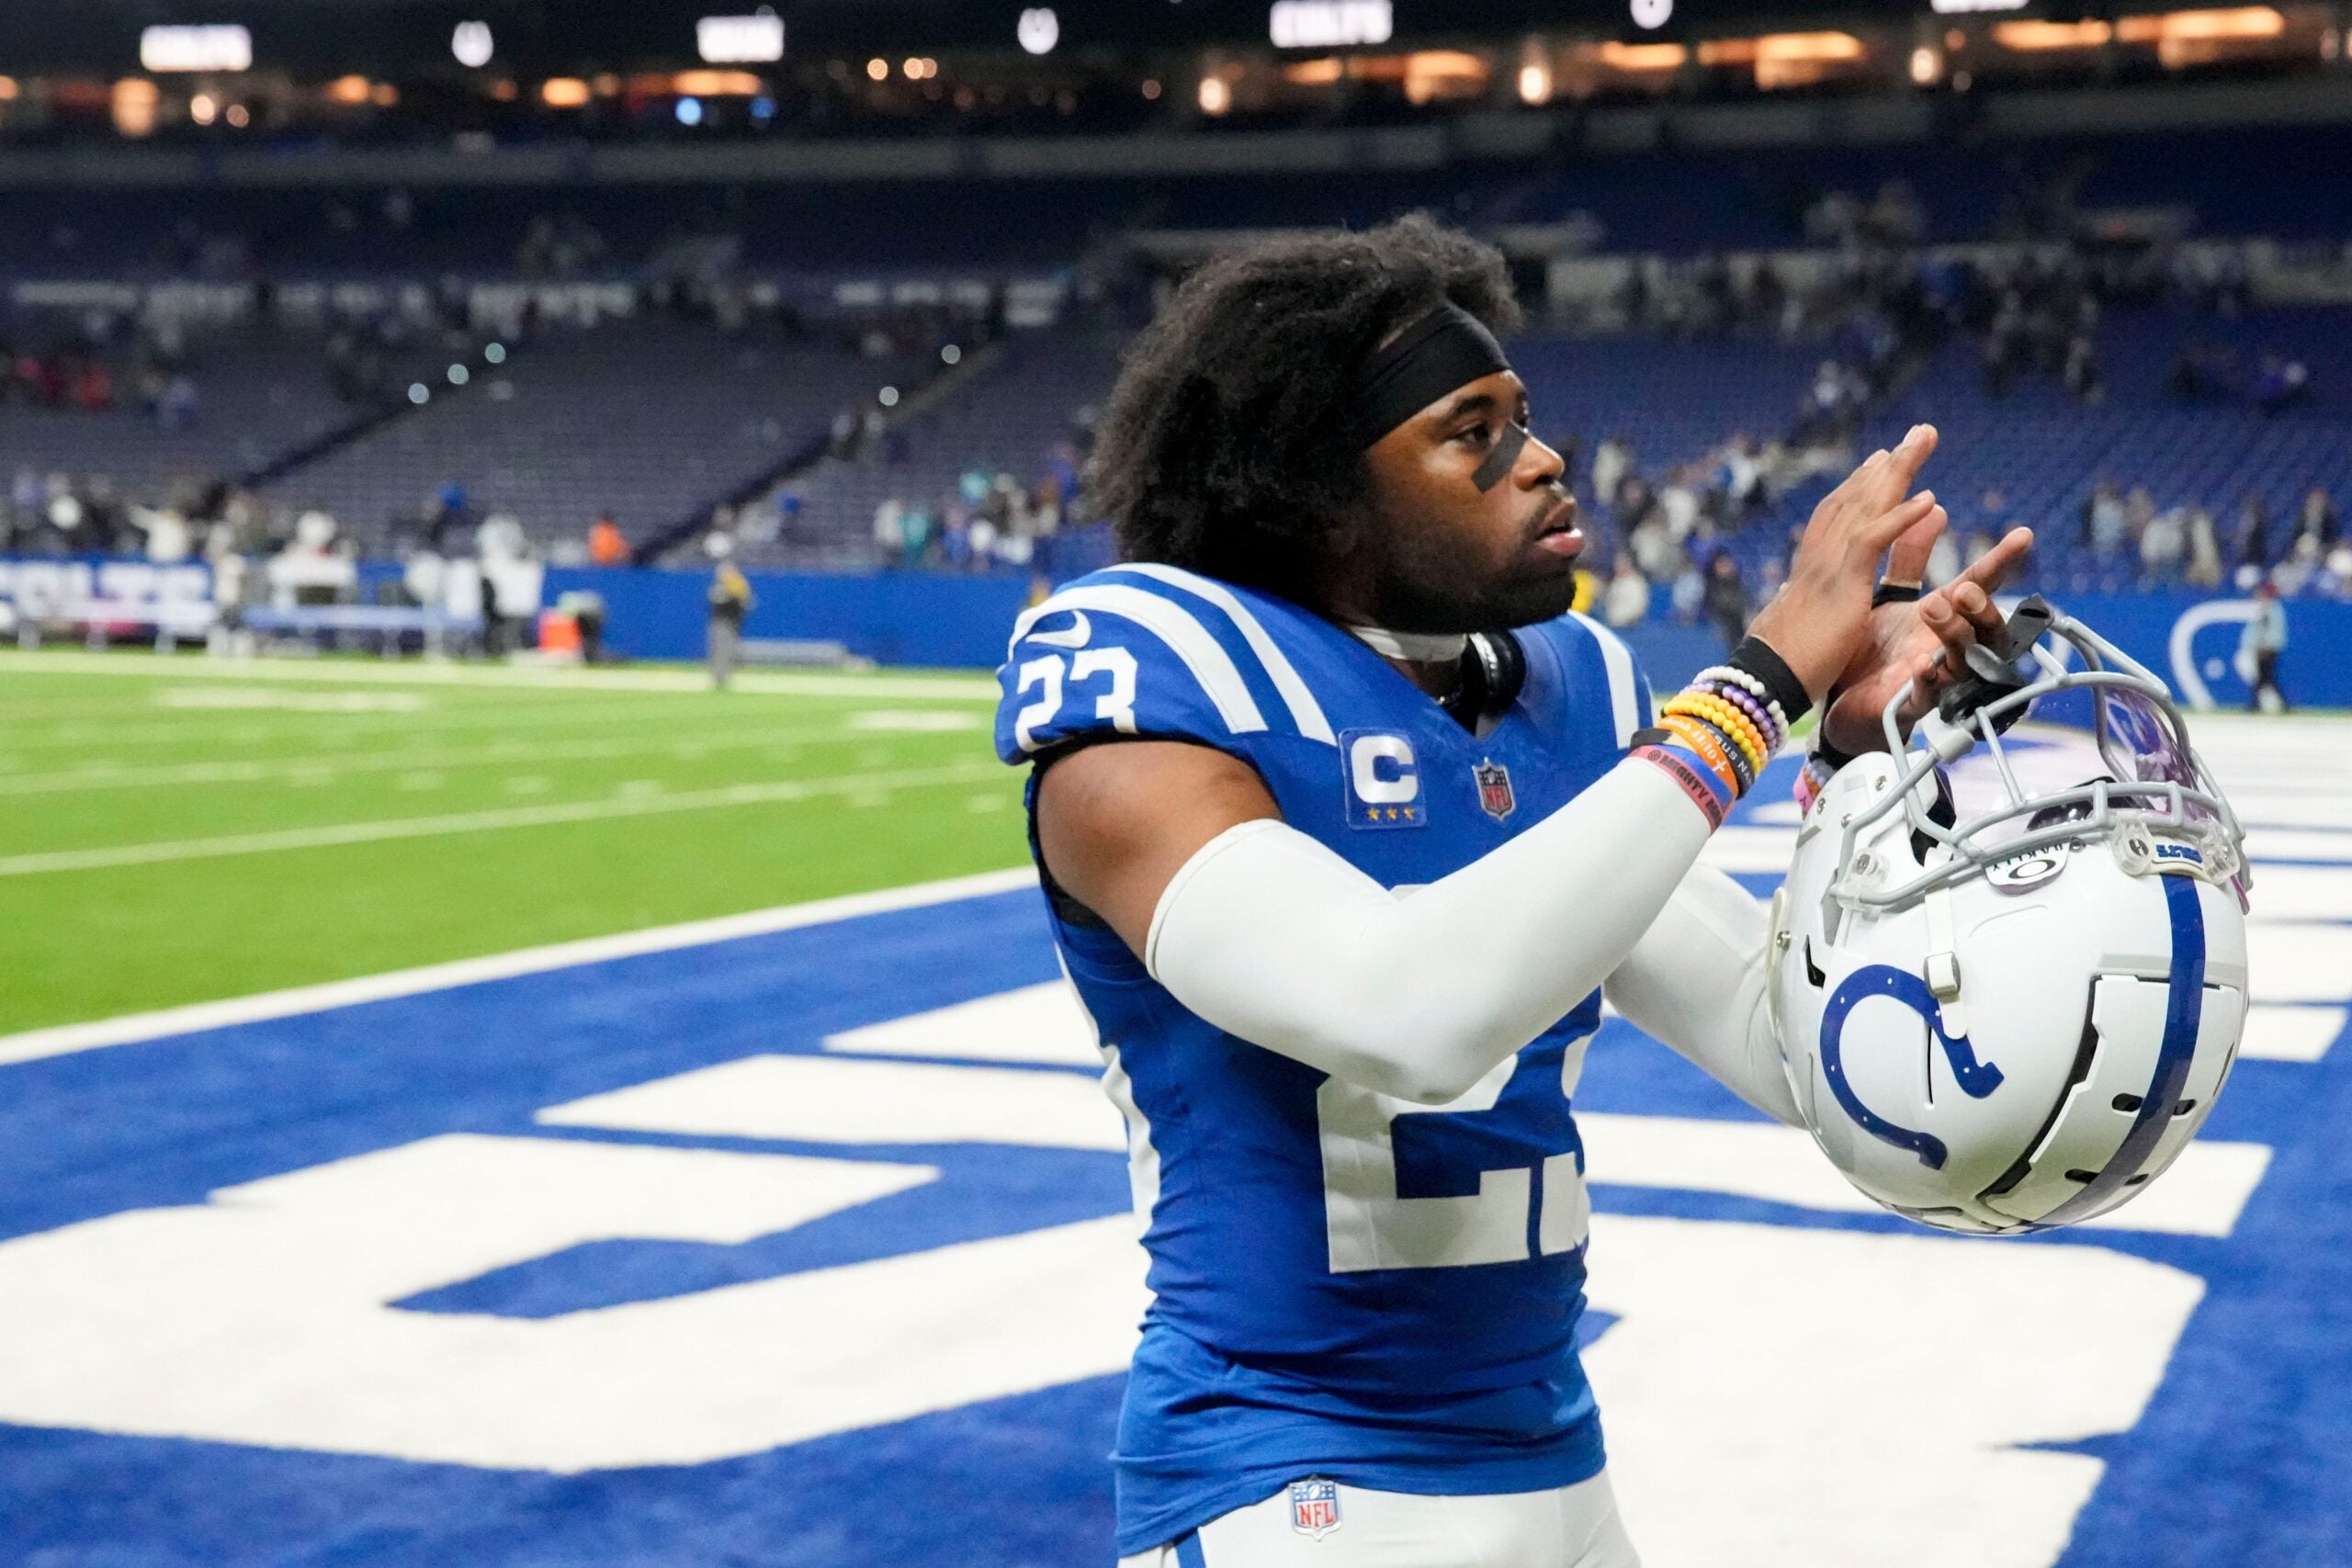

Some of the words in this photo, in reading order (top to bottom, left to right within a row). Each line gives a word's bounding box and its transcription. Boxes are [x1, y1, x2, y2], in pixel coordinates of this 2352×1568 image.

[1015, 647, 1138, 751] 23
[1702, 724, 1738, 761] ESUS
[1351, 735, 1420, 804] C
[1483, 785, 1510, 808] NFL
[1298, 1502, 1335, 1529] NFL
